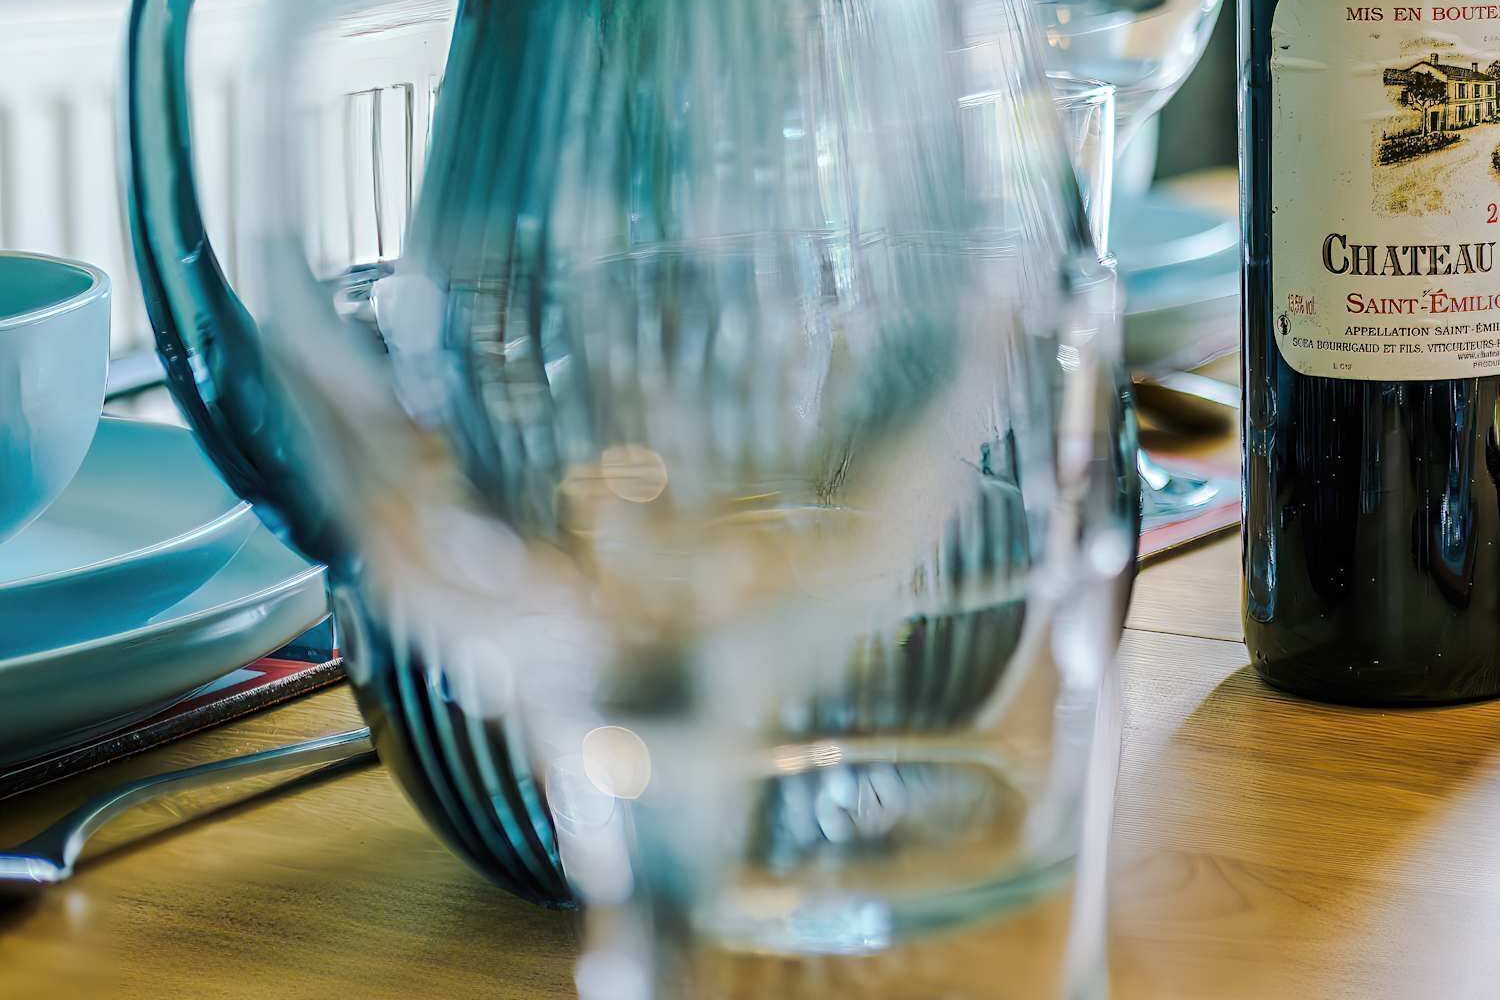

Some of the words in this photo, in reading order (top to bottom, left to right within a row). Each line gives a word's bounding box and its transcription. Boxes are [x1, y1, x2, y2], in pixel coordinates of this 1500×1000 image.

[1346, 7, 1384, 21] MIS
[1393, 7, 1423, 21] EN
[1322, 233, 1496, 276] CHATEAU
[1344, 326, 1429, 337] APPELLATION
[1316, 340, 1380, 353] BOURRIGAUD
[1383, 344, 1397, 354] ET
